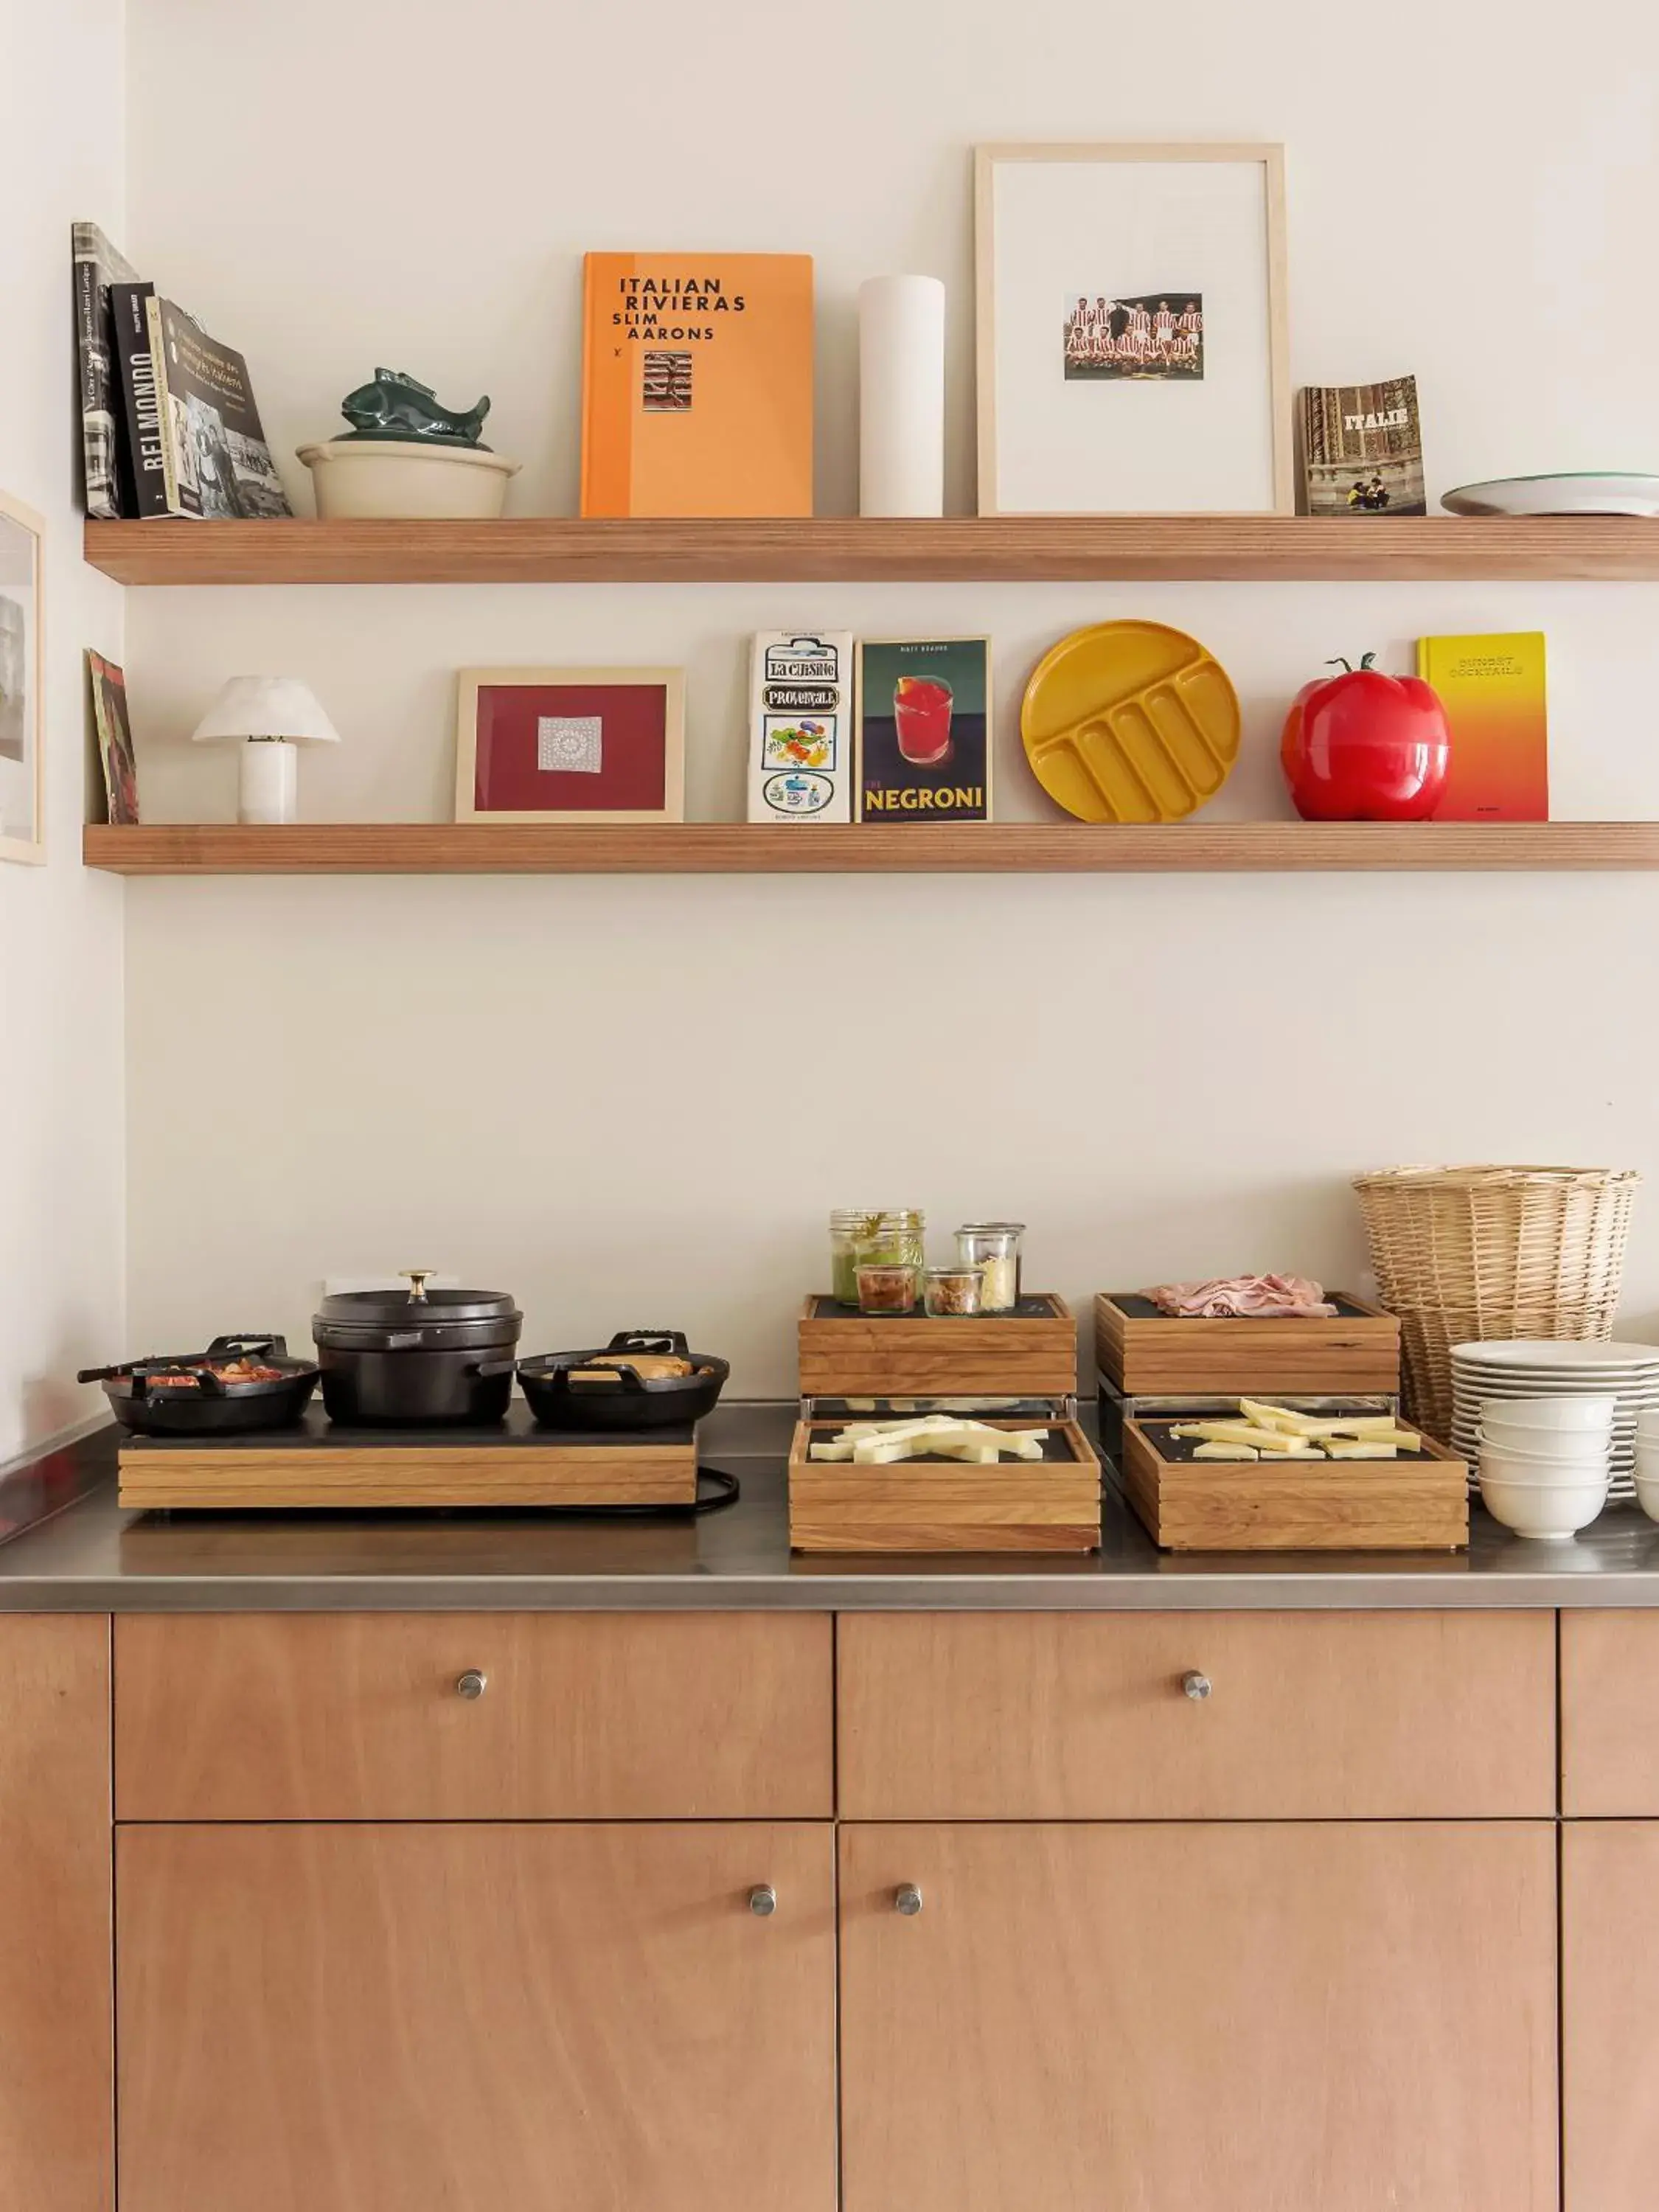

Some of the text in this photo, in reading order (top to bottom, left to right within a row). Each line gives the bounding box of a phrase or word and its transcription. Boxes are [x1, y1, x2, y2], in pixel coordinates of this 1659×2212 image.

[620, 278, 721, 293] ITALIAN
[626, 296, 745, 311] RIVIERAS
[613, 313, 658, 325] SLIM
[627, 328, 714, 340] AARONS
[130, 353, 164, 471] BELMONDO
[1344, 408, 1408, 430] ITALIE
[865, 787, 983, 811] NEGRONI
